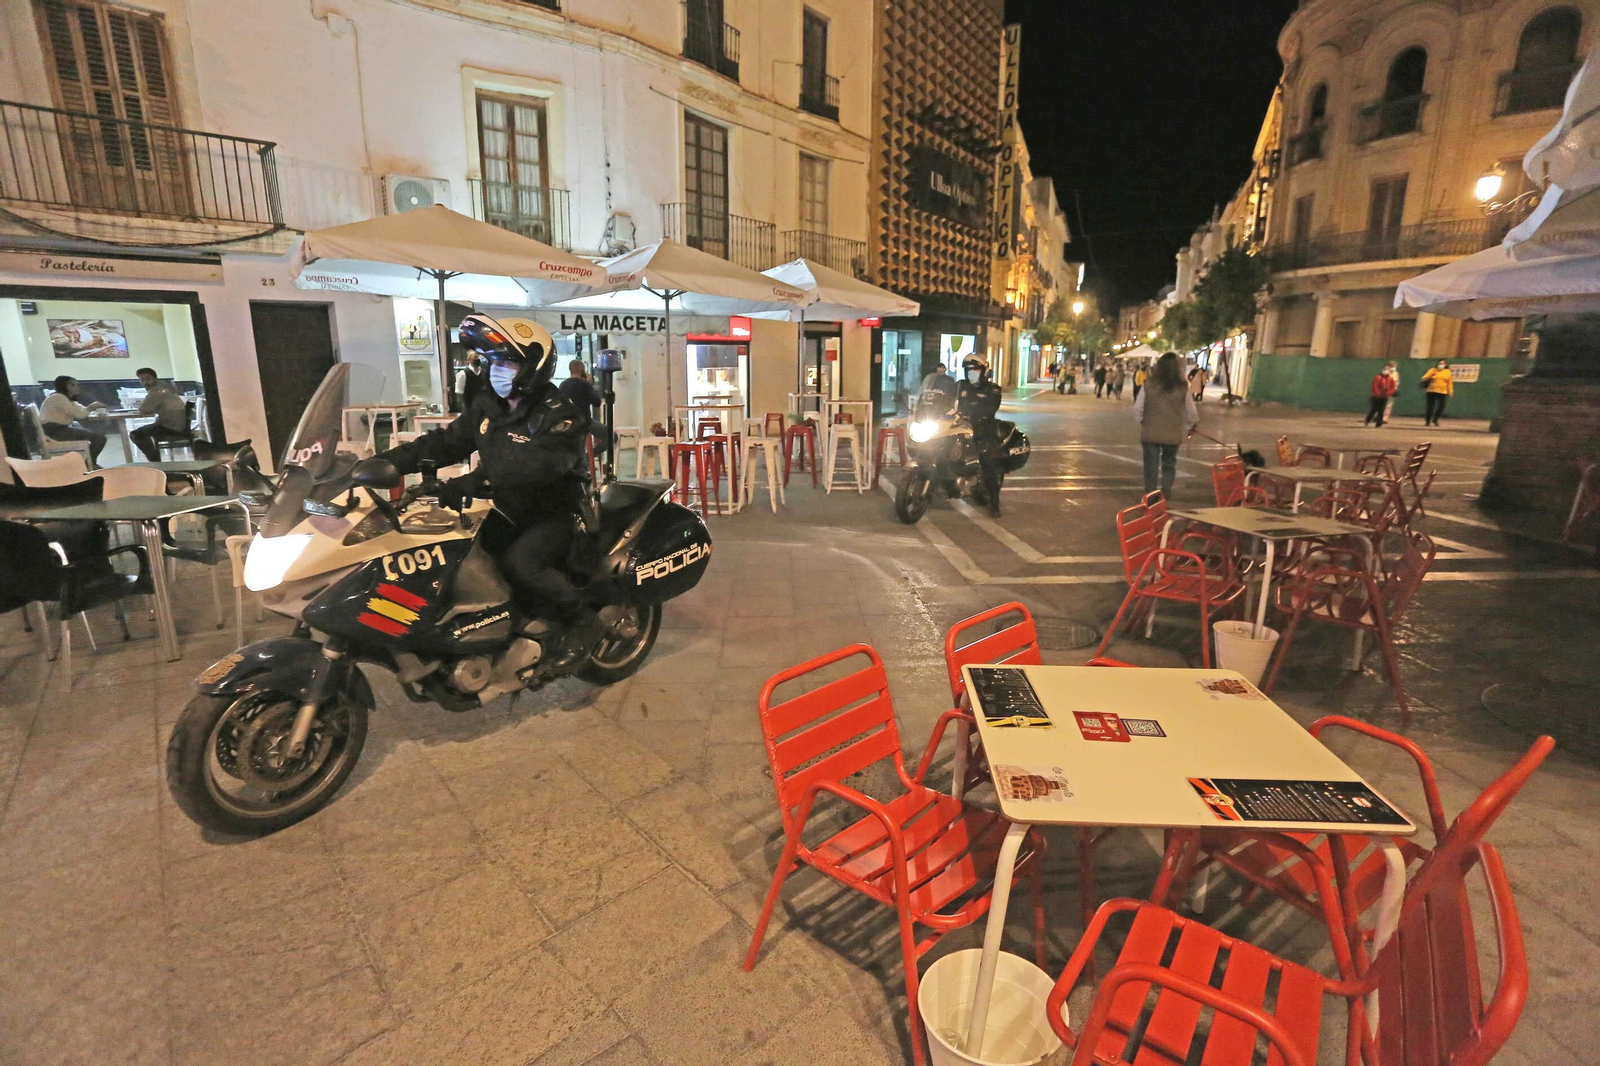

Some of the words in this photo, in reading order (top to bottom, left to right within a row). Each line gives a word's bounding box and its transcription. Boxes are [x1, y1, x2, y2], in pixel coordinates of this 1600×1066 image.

[1003, 29, 1019, 130] ULLOA
[999, 145, 1013, 258] OPTICO
[40, 258, 115, 272] Pastelería
[539, 260, 593, 277] Cruzcampo
[261, 278, 276, 286] 23
[560, 313, 587, 331] LA
[593, 314, 667, 332] MACETA
[636, 542, 712, 586] POLICIA
